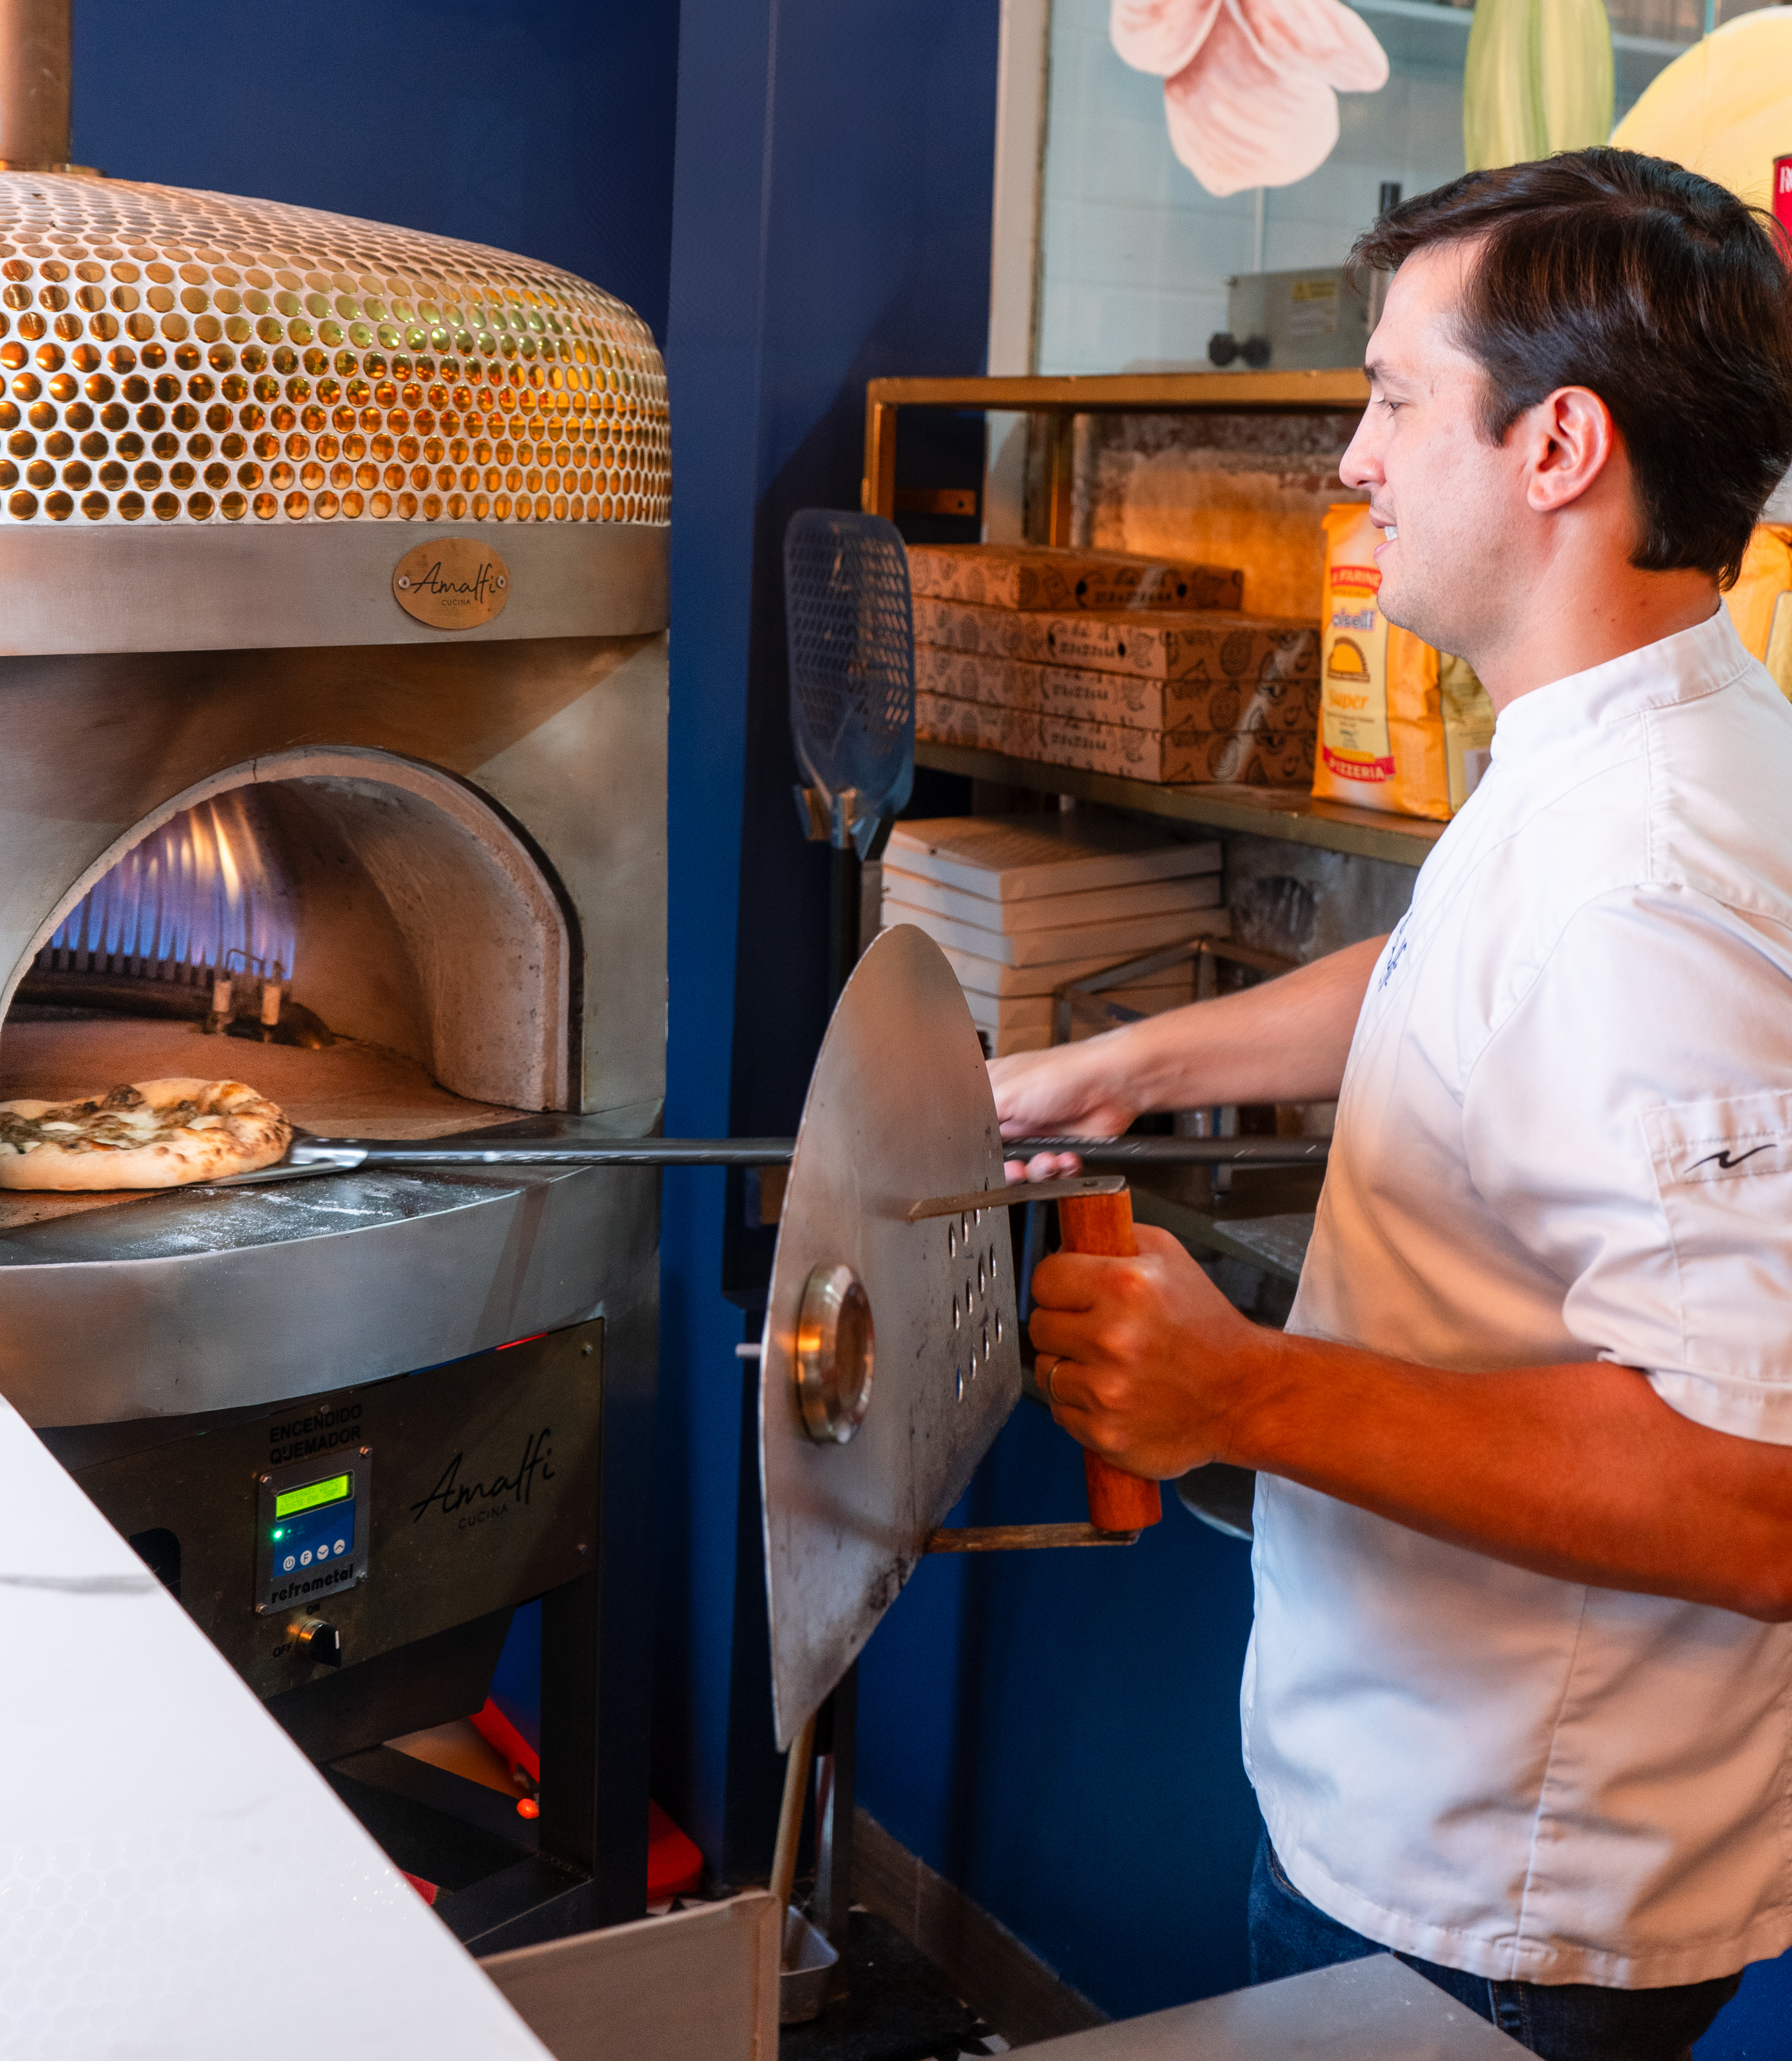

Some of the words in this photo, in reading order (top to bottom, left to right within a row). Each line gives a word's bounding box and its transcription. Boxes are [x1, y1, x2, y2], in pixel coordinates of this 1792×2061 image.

[410, 561, 495, 604] Amalfi
[270, 1404, 362, 1442] ENCENDIDO
[270, 1425, 361, 1463] QUEMADOR
[410, 1427, 556, 1523] Amalfi
[458, 1503, 508, 1529] CUCINA
[303, 1553, 309, 1563] F
[271, 1564, 353, 1604] reframetal
[306, 1603, 320, 1615] ON
[273, 1642, 293, 1657] OFF
